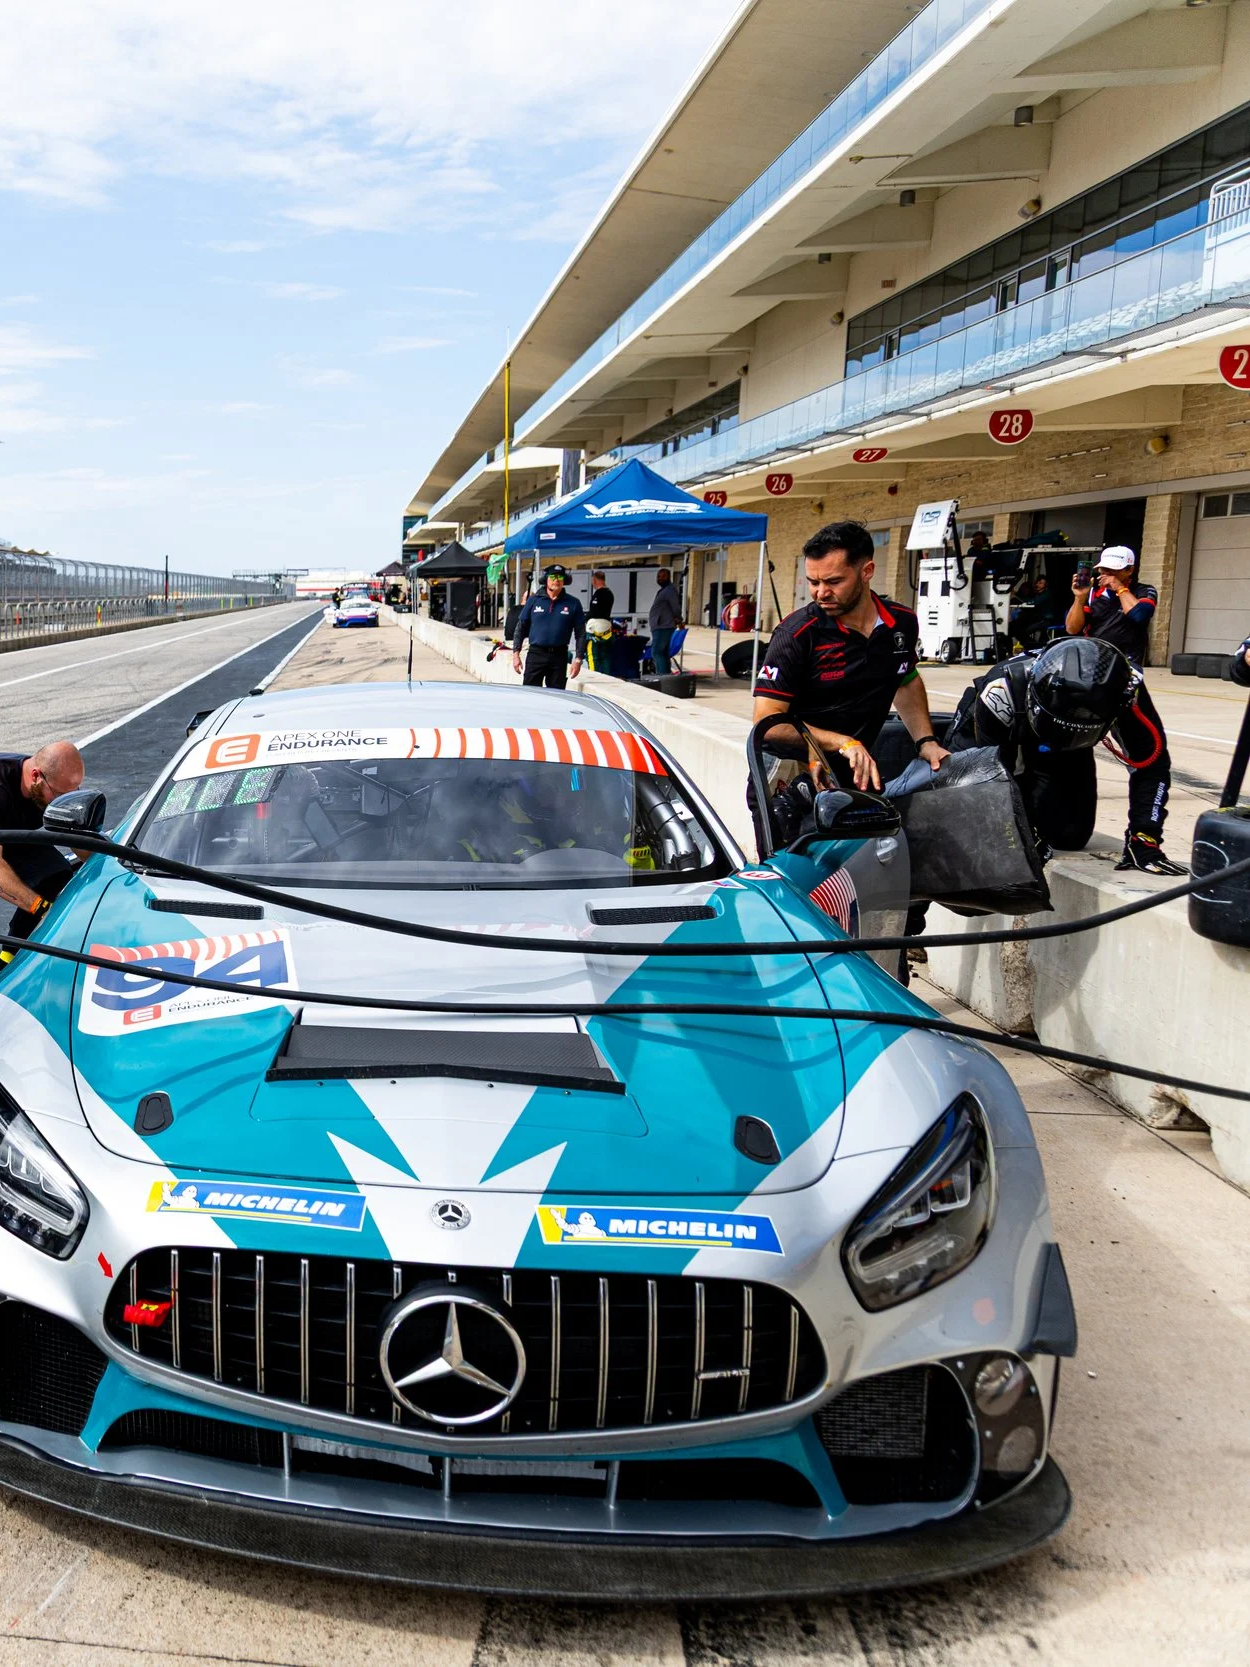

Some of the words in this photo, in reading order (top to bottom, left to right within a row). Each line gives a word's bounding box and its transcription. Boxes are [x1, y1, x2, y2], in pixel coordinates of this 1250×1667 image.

[999, 414, 1023, 437] 28
[858, 449, 881, 461] 27
[771, 475, 787, 492] 26
[709, 492, 723, 505] 25
[267, 737, 389, 752] ENDURANCE
[270, 731, 318, 743] APEX
[322, 729, 362, 739] ONE
[91, 940, 289, 1011] 94
[203, 1191, 346, 1217] MICHELIN
[609, 1218, 757, 1240] MICHELIN
